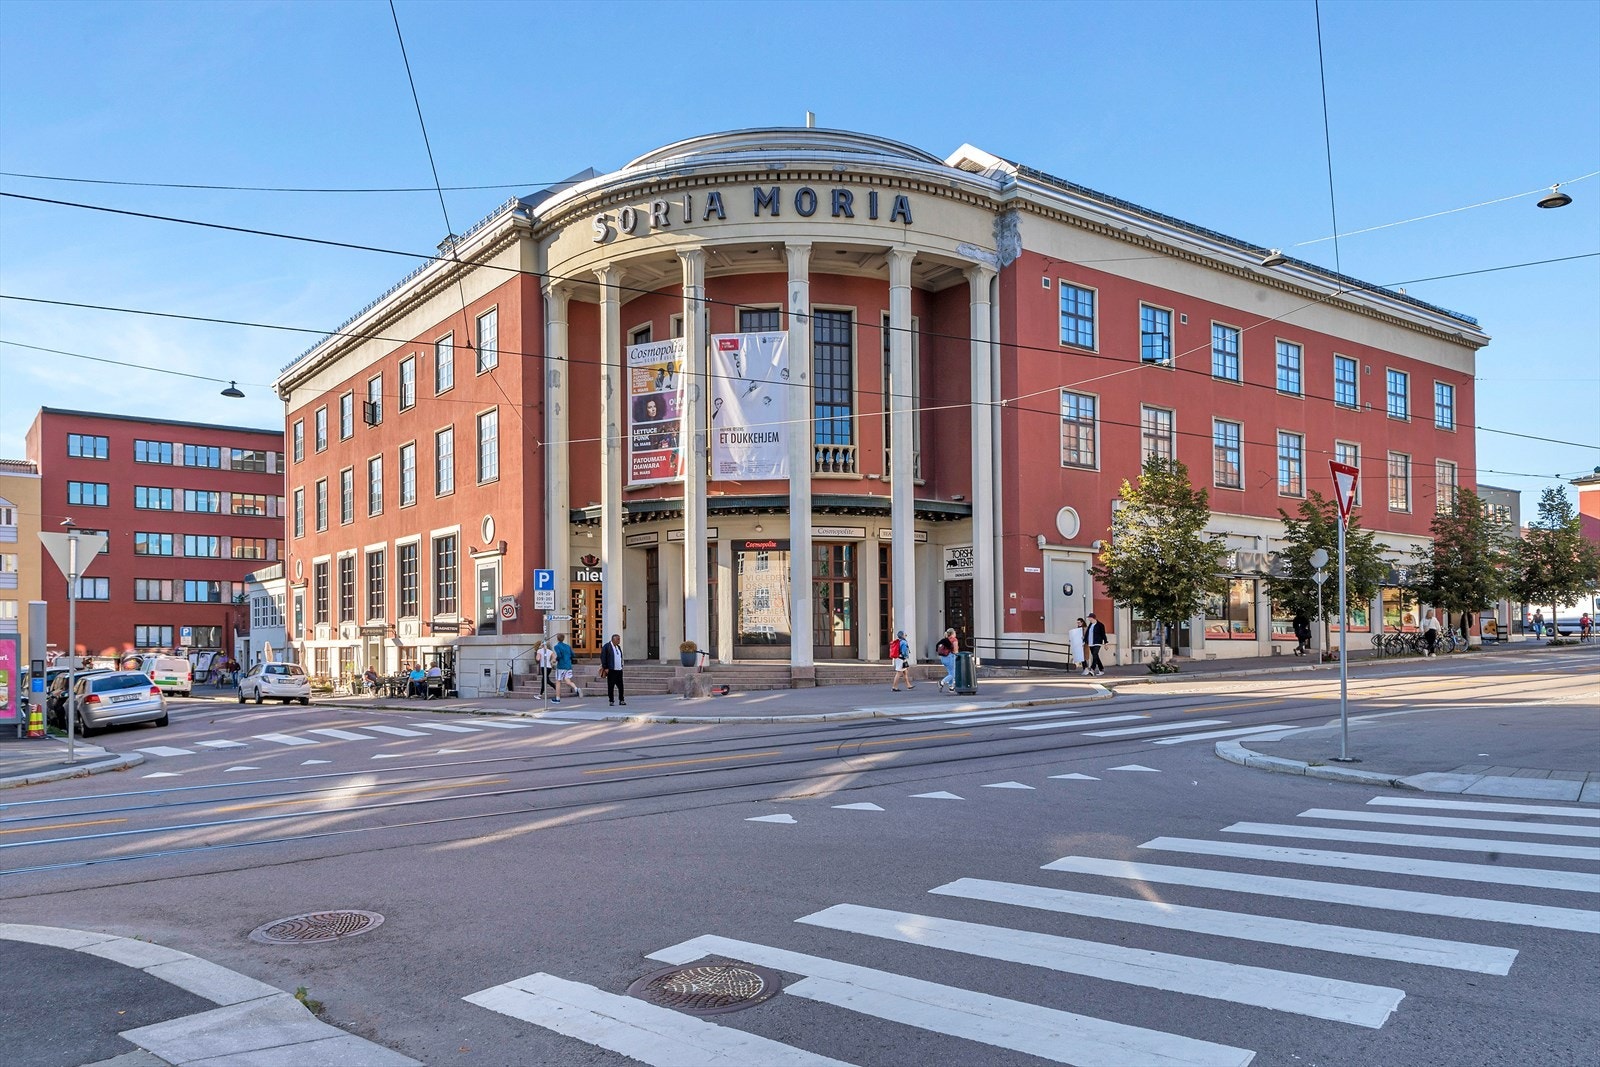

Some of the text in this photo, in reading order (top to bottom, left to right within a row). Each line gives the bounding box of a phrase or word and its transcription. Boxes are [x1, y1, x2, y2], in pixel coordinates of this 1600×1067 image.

[592, 186, 913, 243] SORIA MORIA
[719, 431, 780, 444] ET DUKKEHJEM
[633, 455, 667, 464] FATOUMATA
[633, 462, 660, 470] DIAWARA
[817, 527, 854, 537] Cosmopolite
[745, 540, 777, 550] Cosmopolite
[539, 572, 550, 588] P
[504, 607, 513, 615] 30
